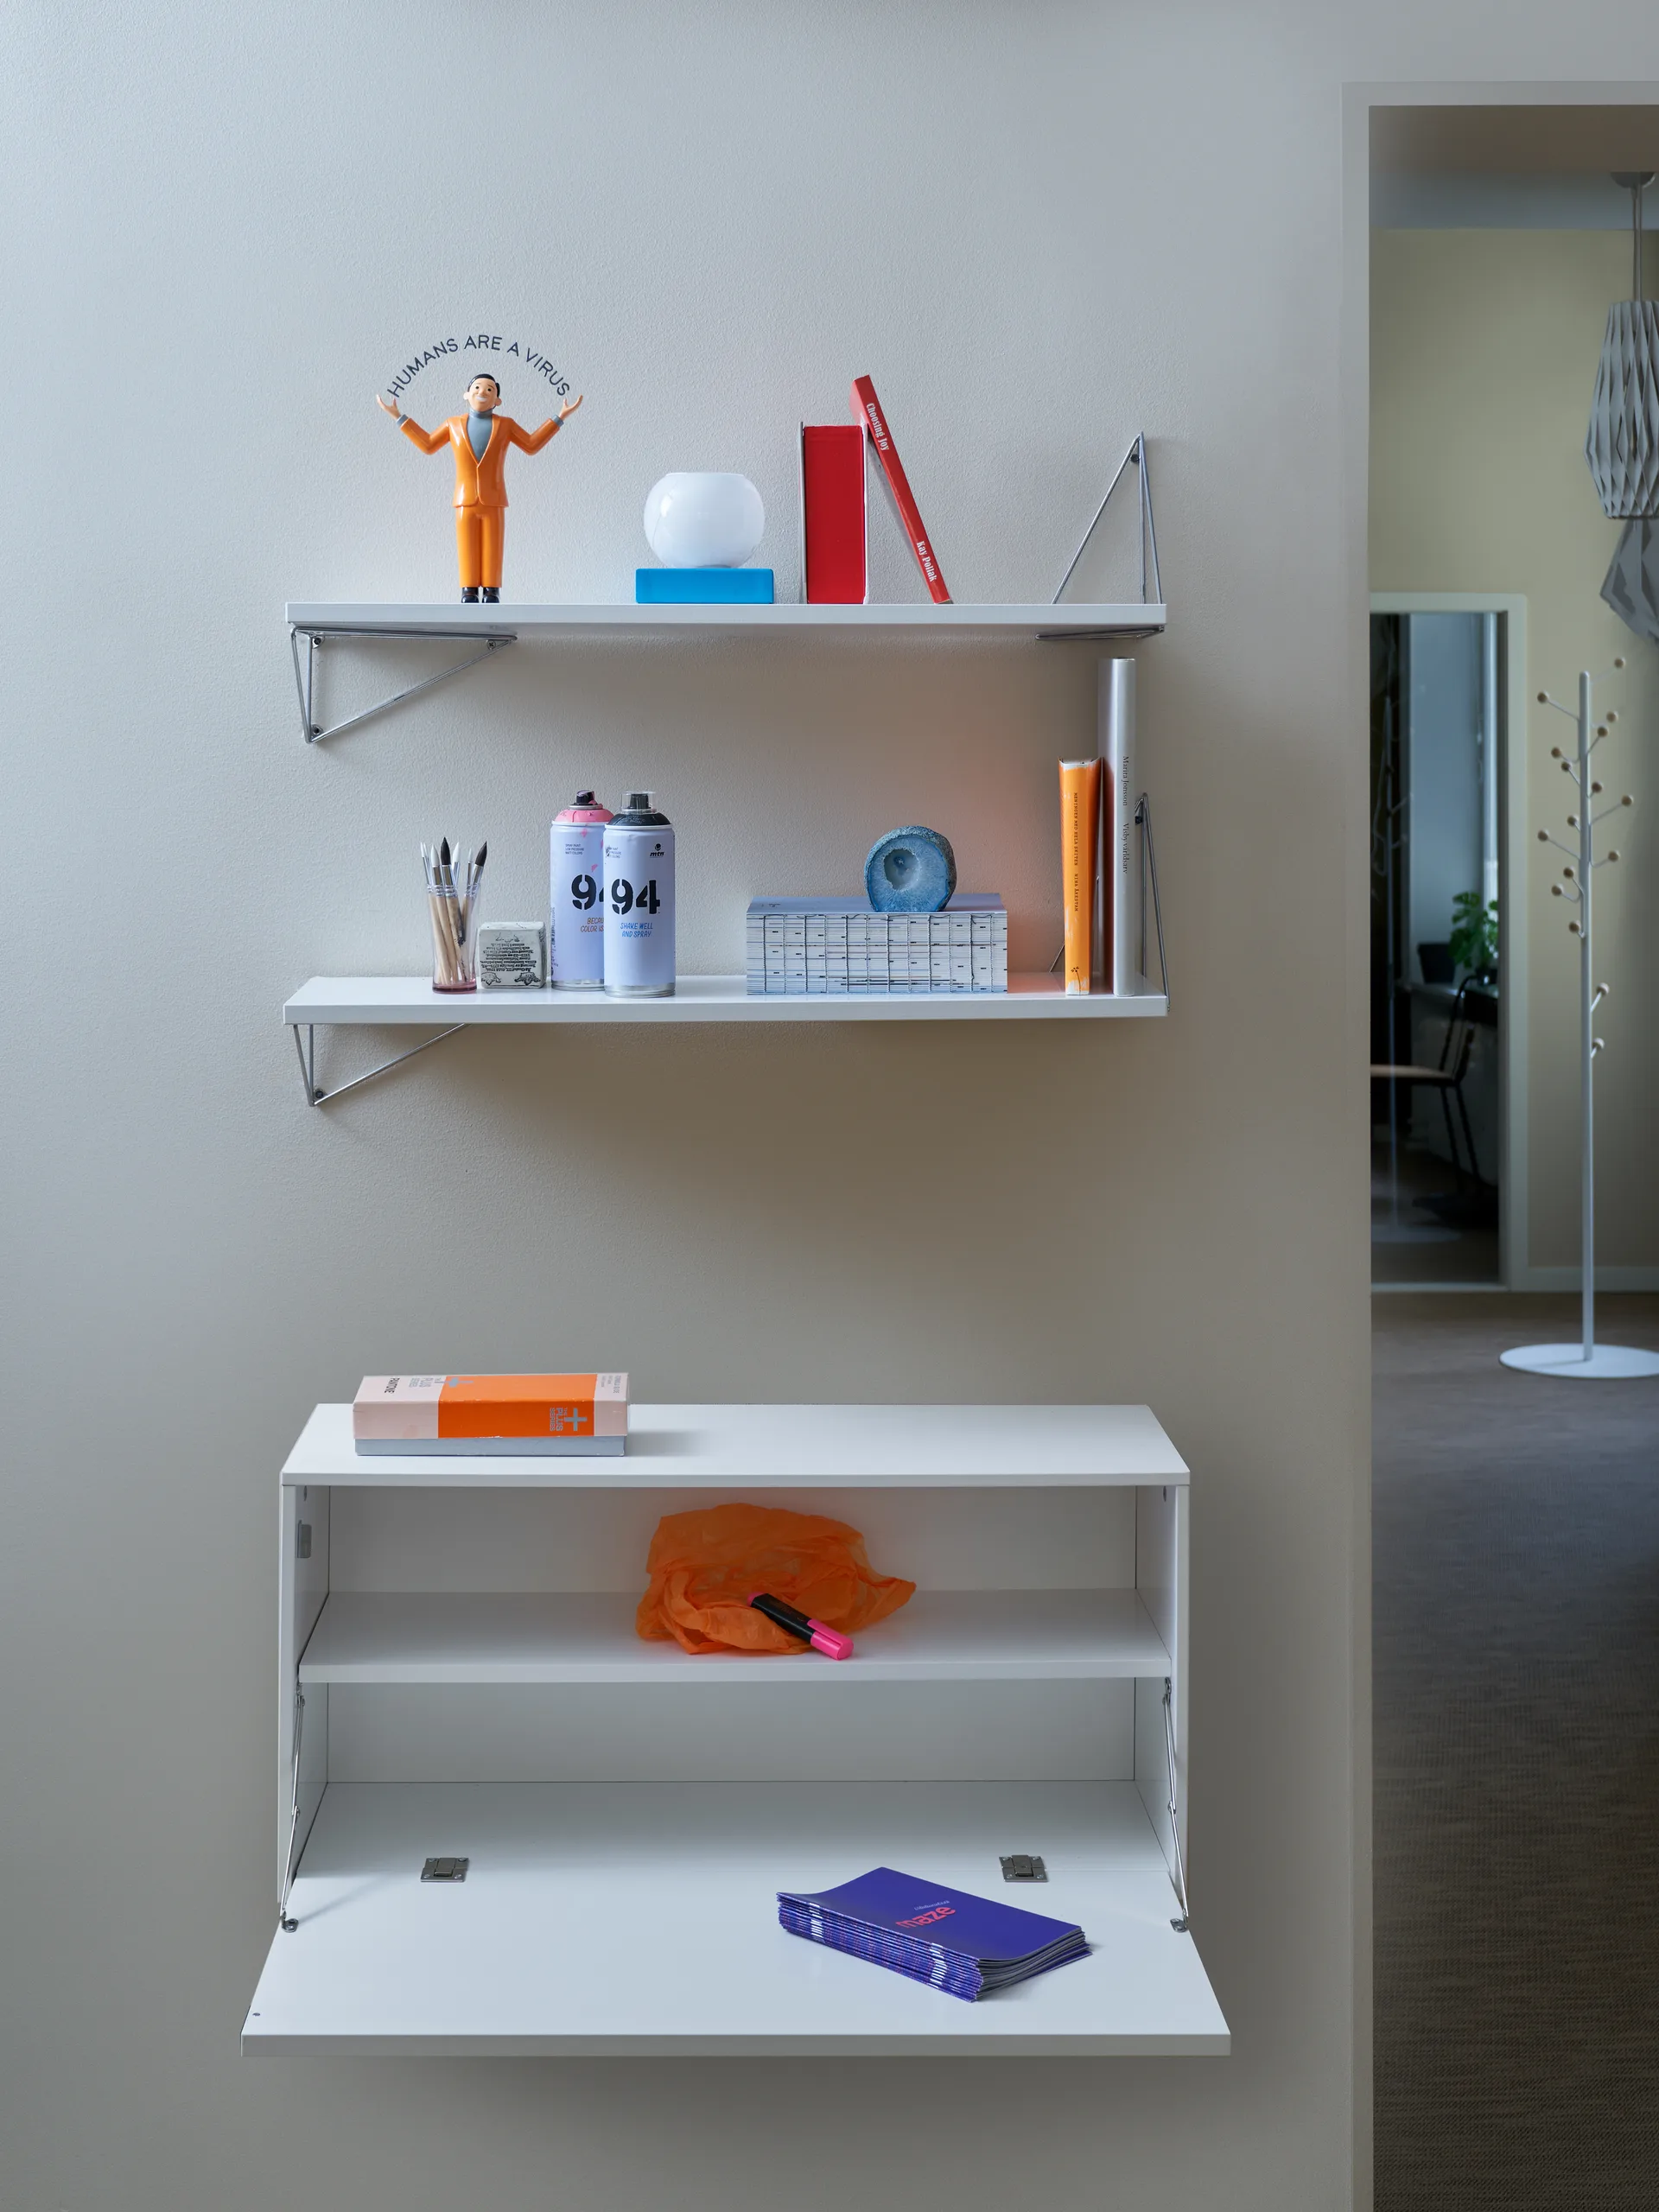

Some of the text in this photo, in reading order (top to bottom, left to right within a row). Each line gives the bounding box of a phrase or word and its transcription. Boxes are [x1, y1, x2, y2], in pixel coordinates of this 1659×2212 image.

[386, 334, 570, 398] HUMANS ARE A VIRUS
[866, 403, 890, 451] Choosing Joy
[916, 540, 938, 582] Kay Pollak
[1121, 779, 1129, 806] Jonsson
[1122, 823, 1130, 842] Visby
[611, 878, 661, 915] 94
[580, 925, 598, 933] COLOR
[556, 1407, 564, 1432] PLUS
[895, 1906, 956, 1929] maze
